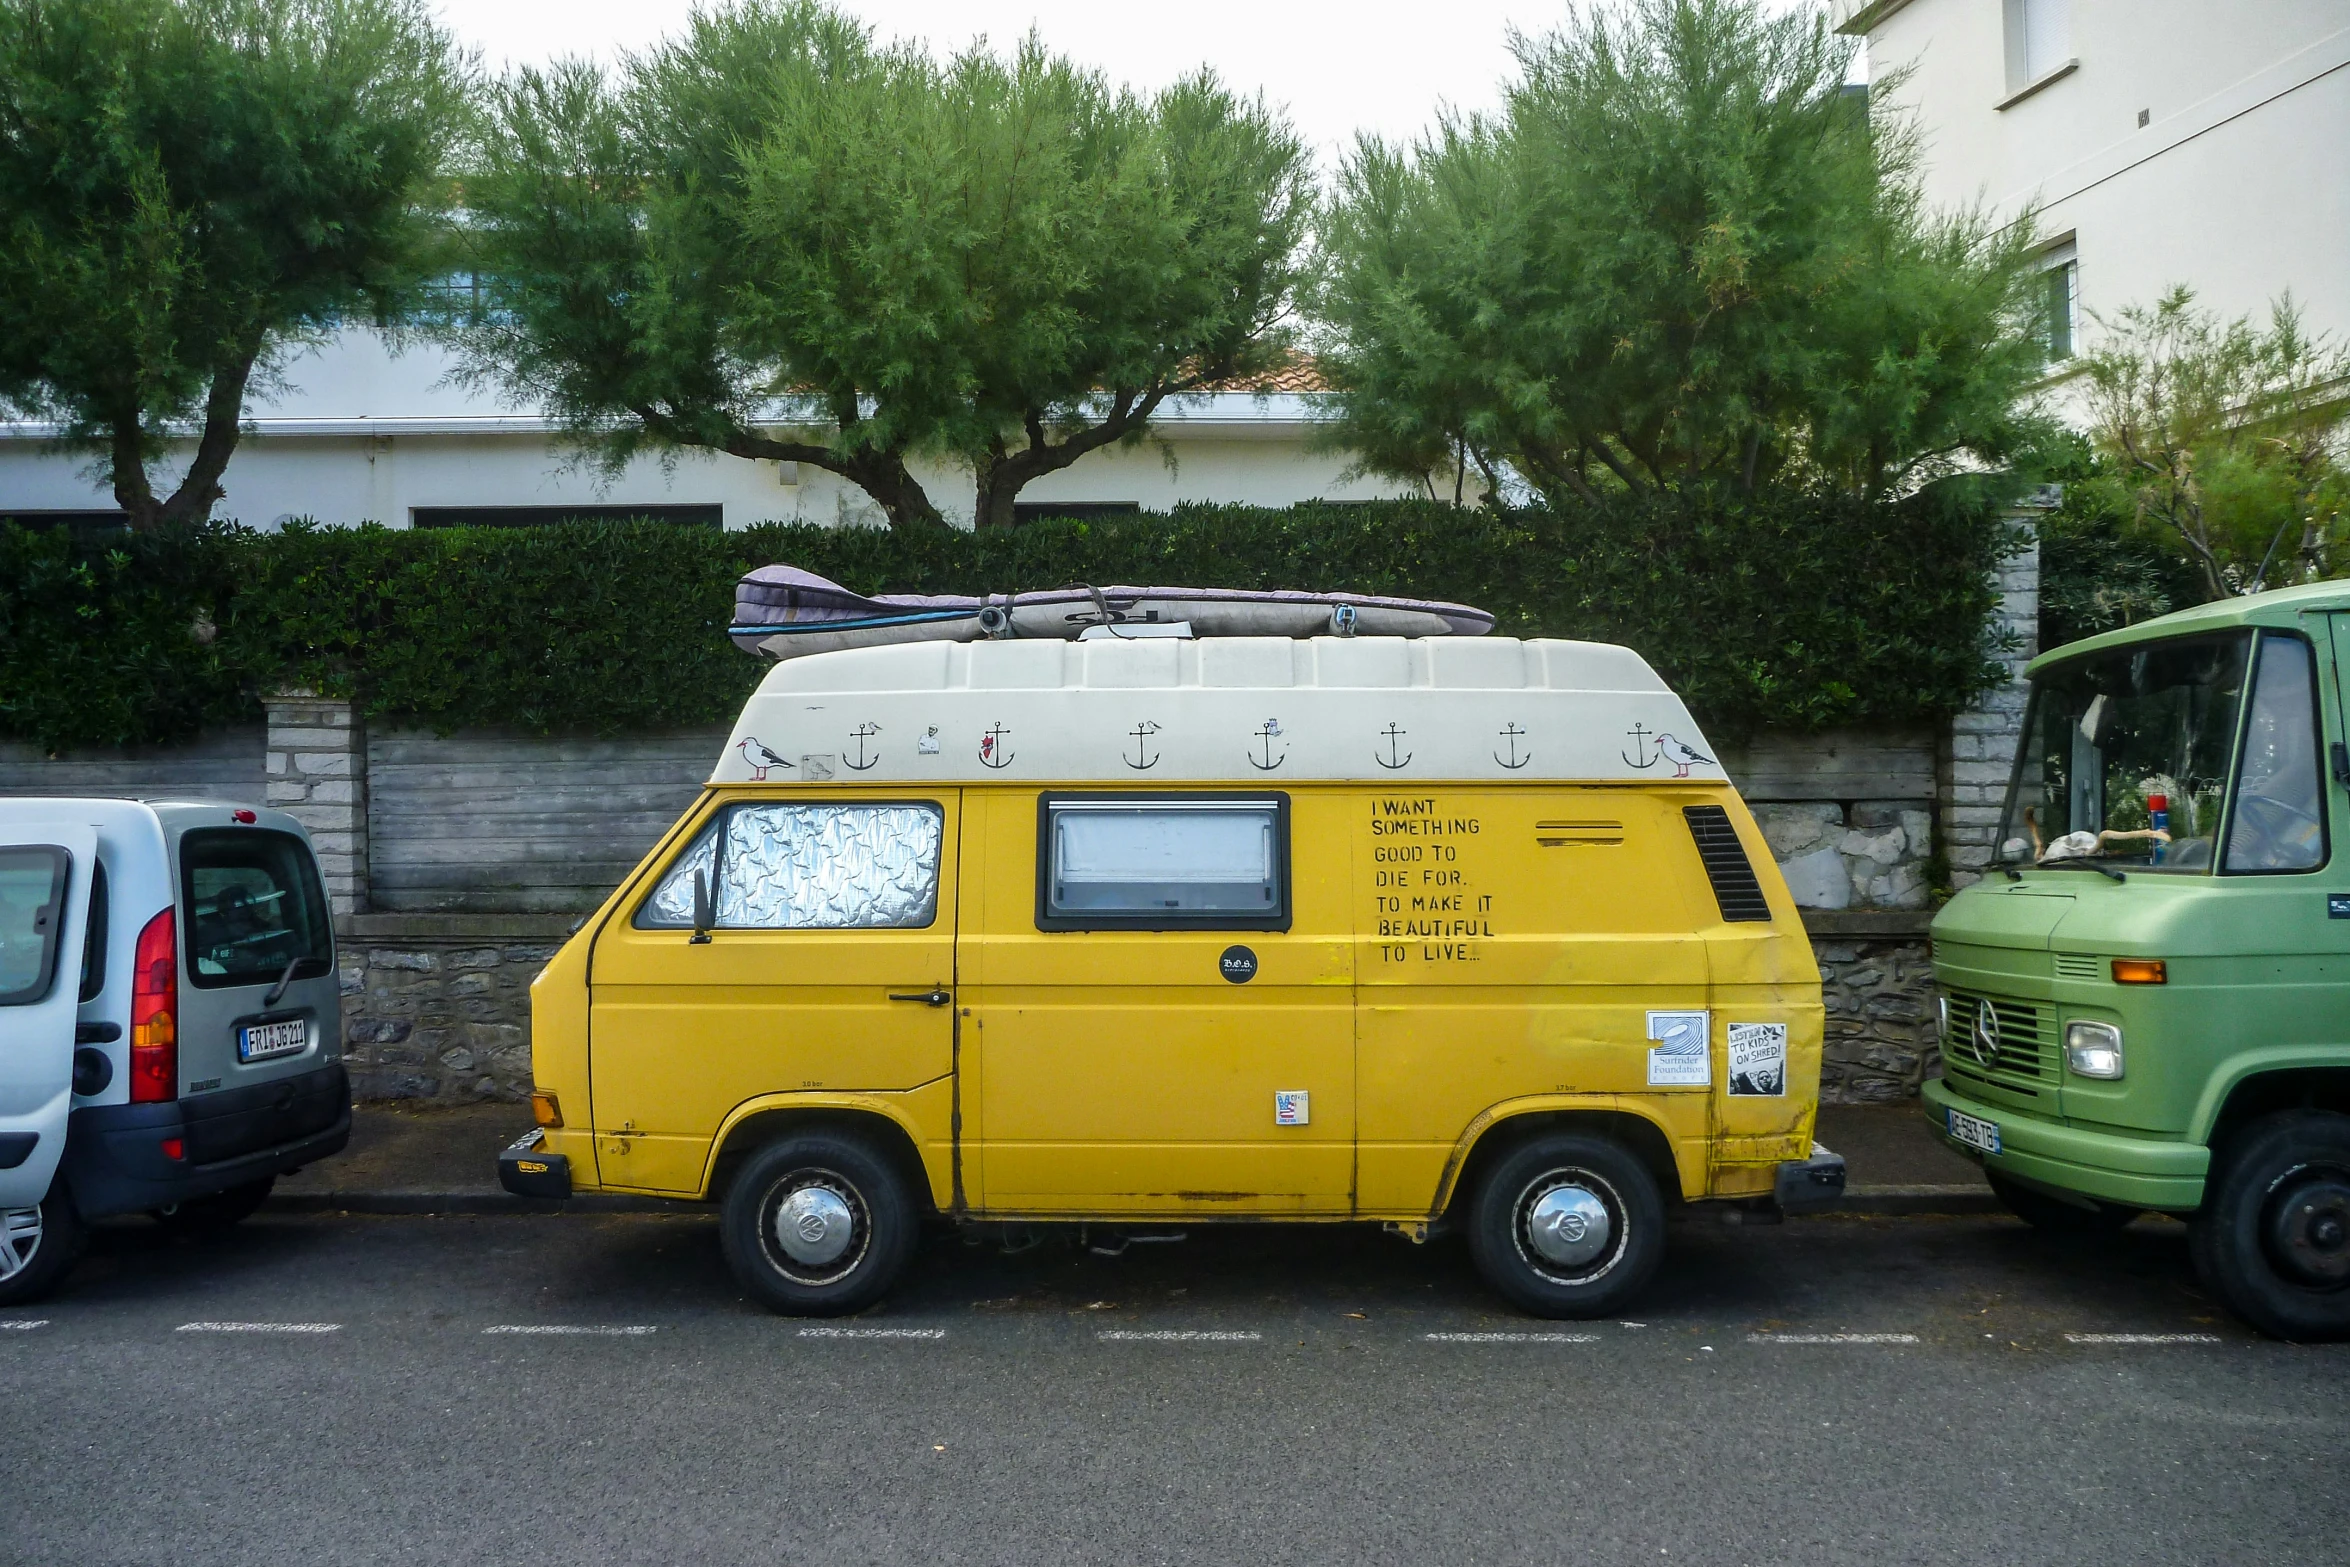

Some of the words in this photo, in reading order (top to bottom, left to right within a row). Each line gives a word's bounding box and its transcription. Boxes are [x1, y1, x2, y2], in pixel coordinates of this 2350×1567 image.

[1372, 801, 1376, 816] I
[1383, 799, 1435, 816] WANT
[1371, 819, 1480, 836] SOMETHING
[1374, 846, 1423, 863] GOOD
[1431, 845, 1456, 862] TO
[1376, 870, 1409, 887] DIE
[1423, 870, 1468, 887] FOR.
[1376, 896, 1400, 913] TO
[1412, 894, 1464, 912] MAKE
[1478, 895, 1493, 913] IT
[1378, 919, 1495, 937] BEAUTIFUL
[1381, 945, 1405, 962] TO
[248, 1028, 269, 1053] FRI
[288, 1023, 304, 1045] 211
[1729, 1026, 1761, 1043] LISTEN
[1731, 1043, 1746, 1054] TO
[1747, 1036, 1770, 1050] KIDS
[1659, 1056, 1699, 1065] Surfrider
[1736, 1053, 1750, 1065] ON
[1751, 1044, 1781, 1061] SHRED!
[1654, 1065, 1704, 1074] Foundation
